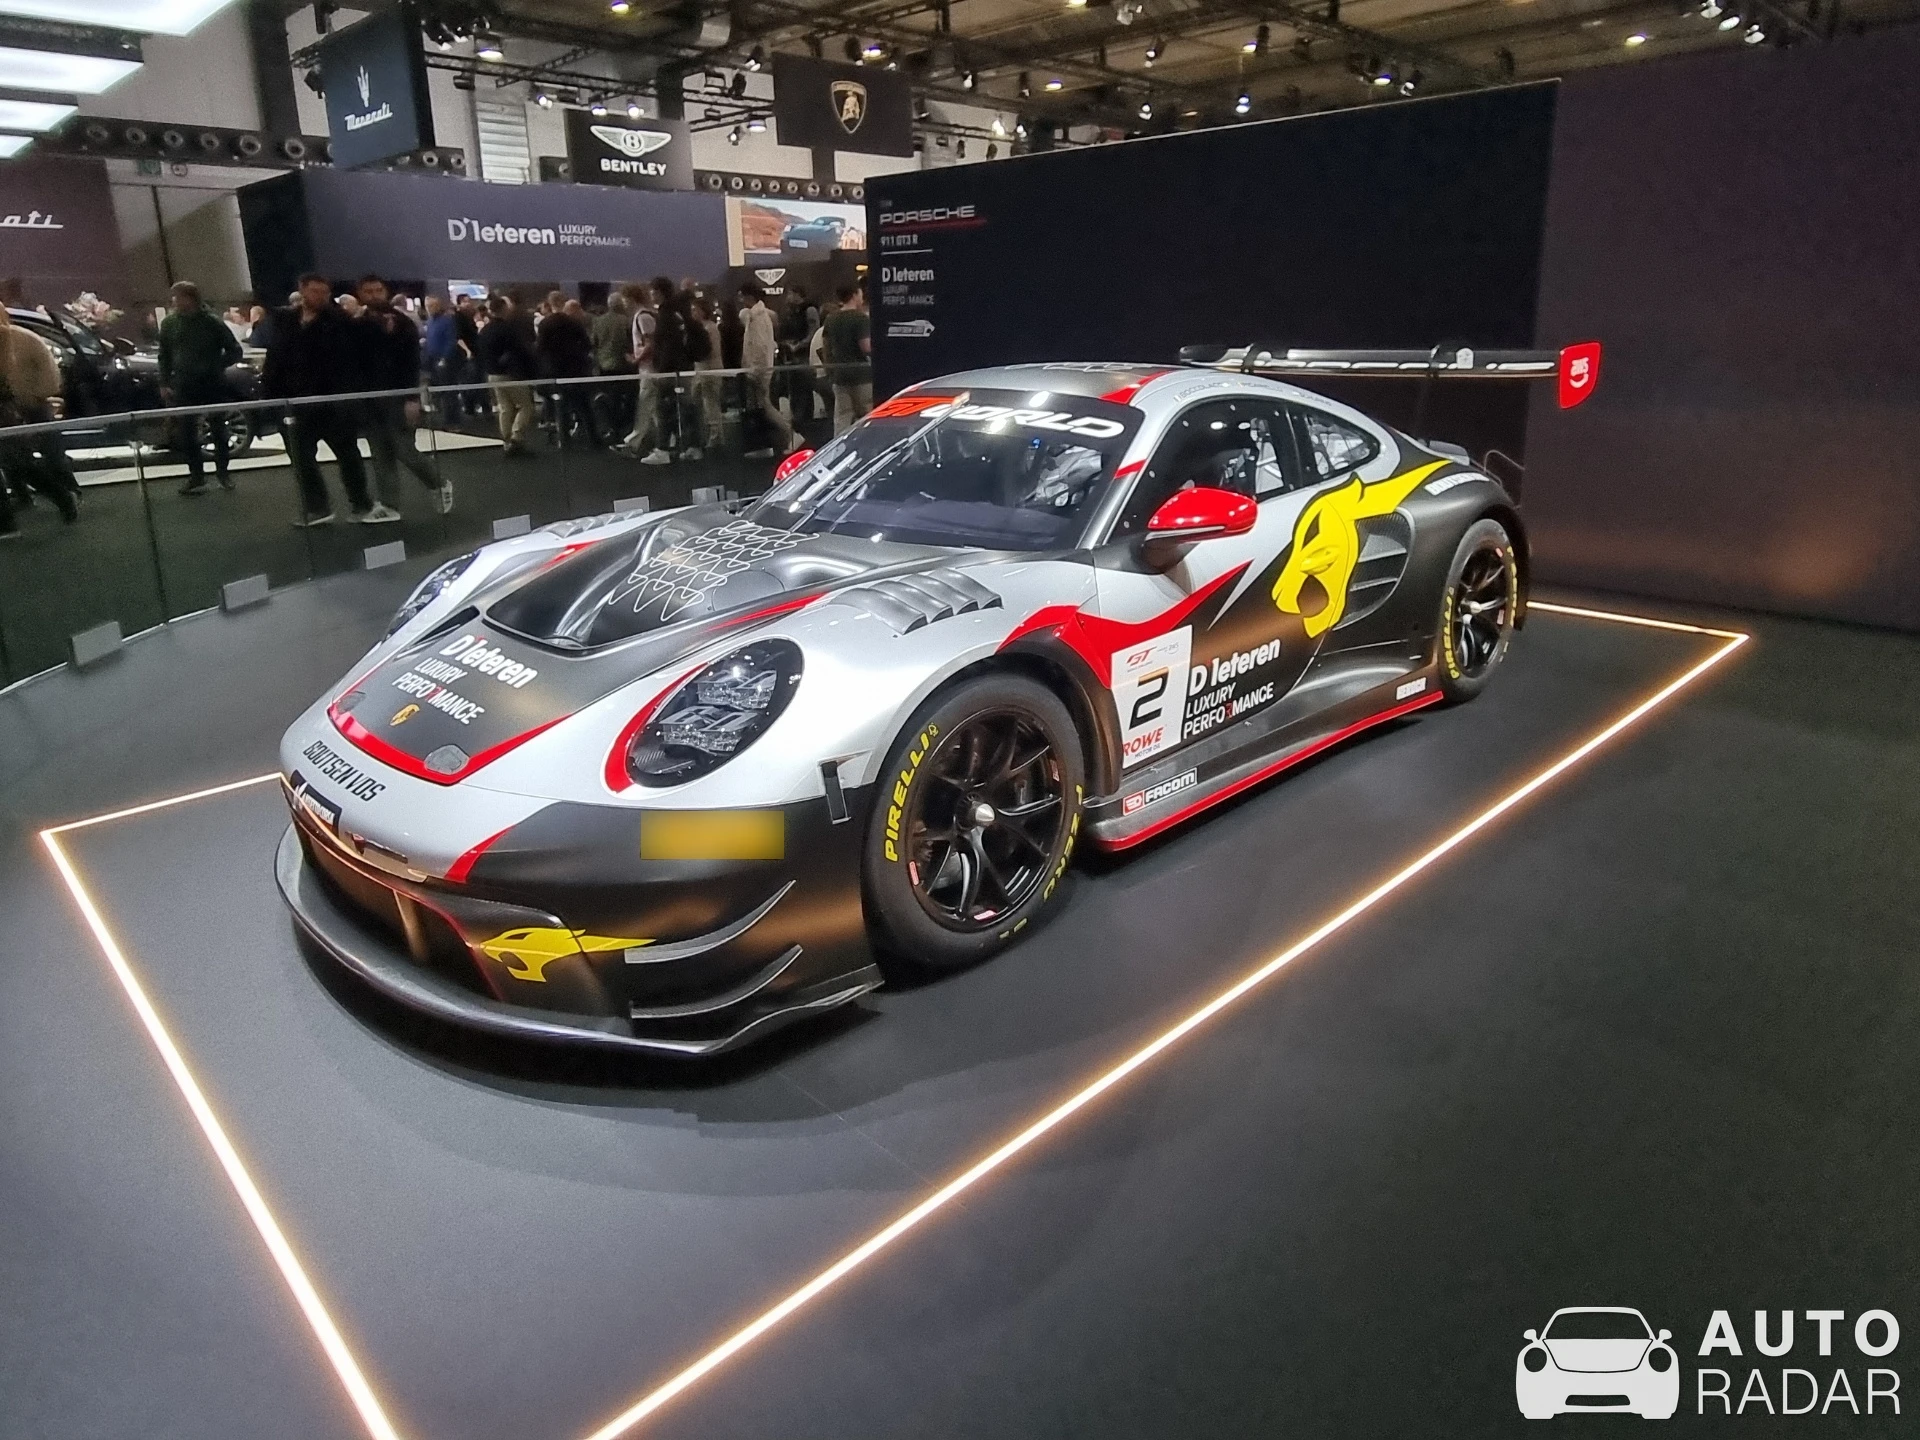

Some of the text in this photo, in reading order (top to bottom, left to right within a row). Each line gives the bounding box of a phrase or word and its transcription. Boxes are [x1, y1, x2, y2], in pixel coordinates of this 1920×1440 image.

[600, 158, 667, 176] BENTLEY
[558, 224, 597, 235] LUXURY
[880, 205, 975, 224] PORSCHE
[560, 235, 632, 247] PERFORMANCE
[920, 403, 1125, 438] WORLD
[414, 657, 468, 684] LUXURY
[1126, 646, 1157, 667] GT
[391, 671, 486, 725] PERFORMANCE
[1128, 667, 1170, 731] 2
[1183, 682, 1274, 740] PERFORMANCE
[1186, 682, 1237, 719] LUXURY
[1122, 727, 1164, 757] ROWE
[302, 740, 387, 802] BOUTSEN VDS
[885, 732, 930, 862] PIRELLI
[1145, 772, 1195, 803] FACOM
